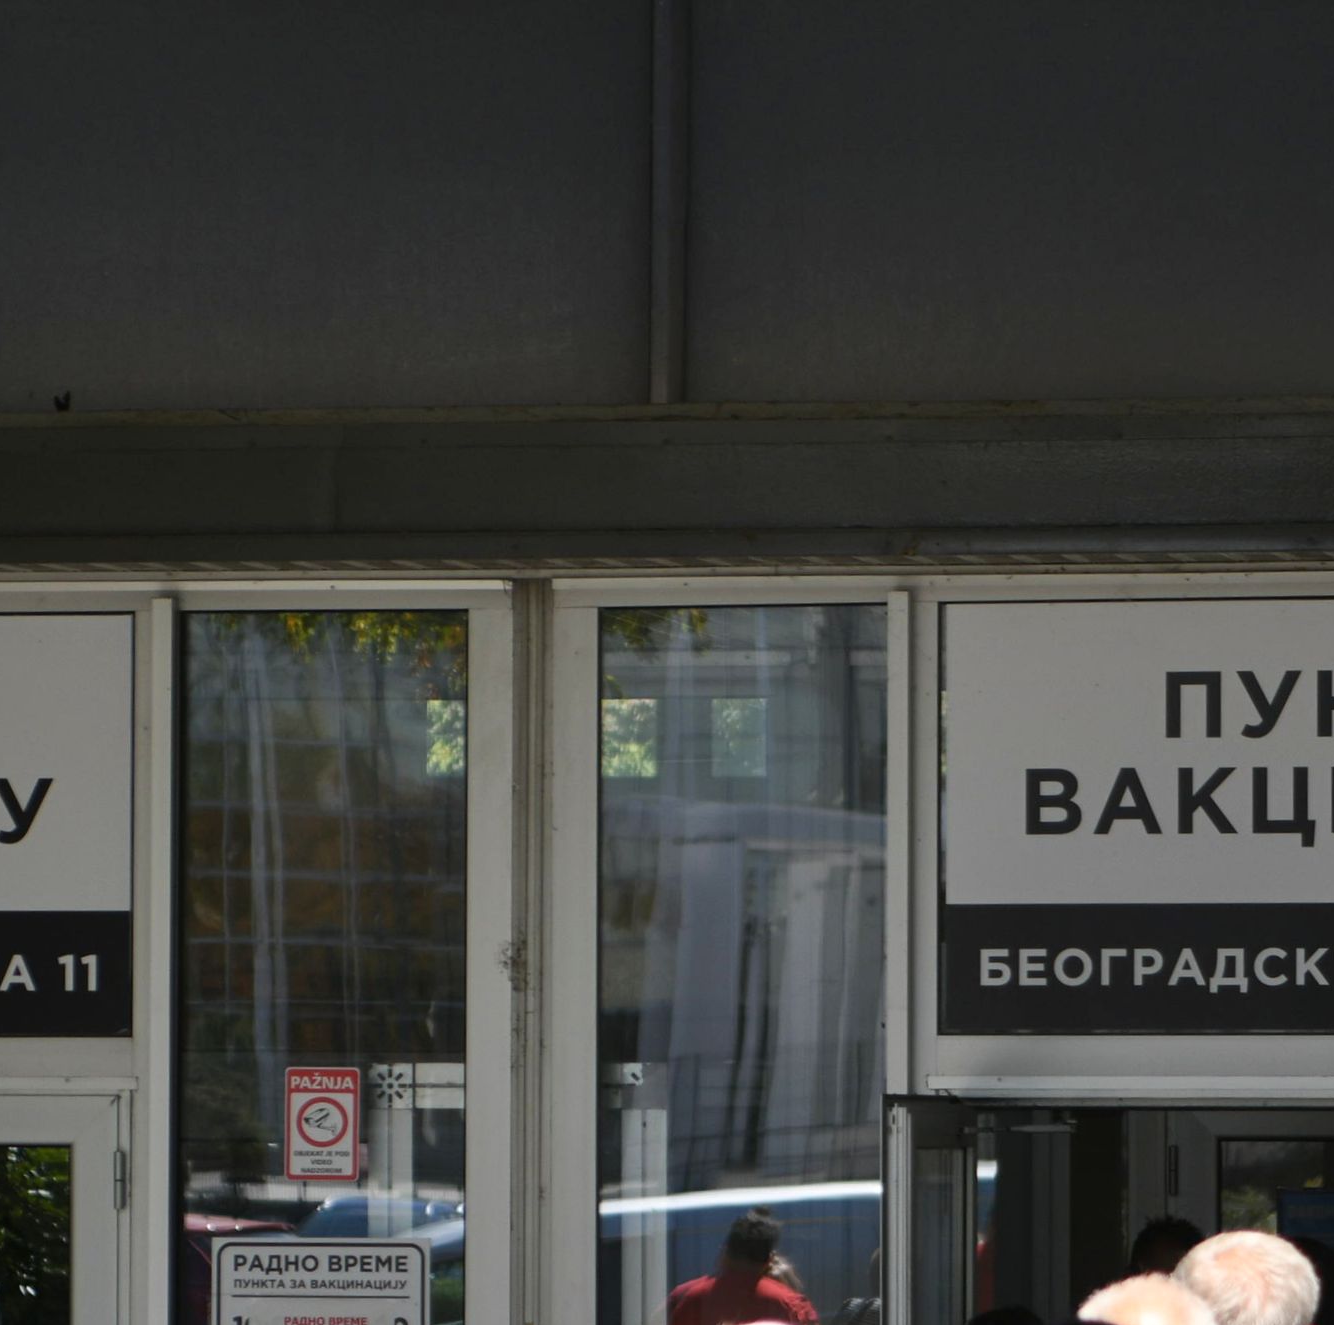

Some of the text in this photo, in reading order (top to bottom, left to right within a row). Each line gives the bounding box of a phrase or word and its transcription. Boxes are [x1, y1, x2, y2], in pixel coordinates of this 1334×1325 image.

[57, 954, 100, 992] 11
[290, 1072, 354, 1090] PAŽNJA
[233, 1254, 409, 1275] РАДНО ВРЕМЕ
[233, 1279, 408, 1290] ПУНКТА ЗА ВАКЦИНАЦИЈУ
